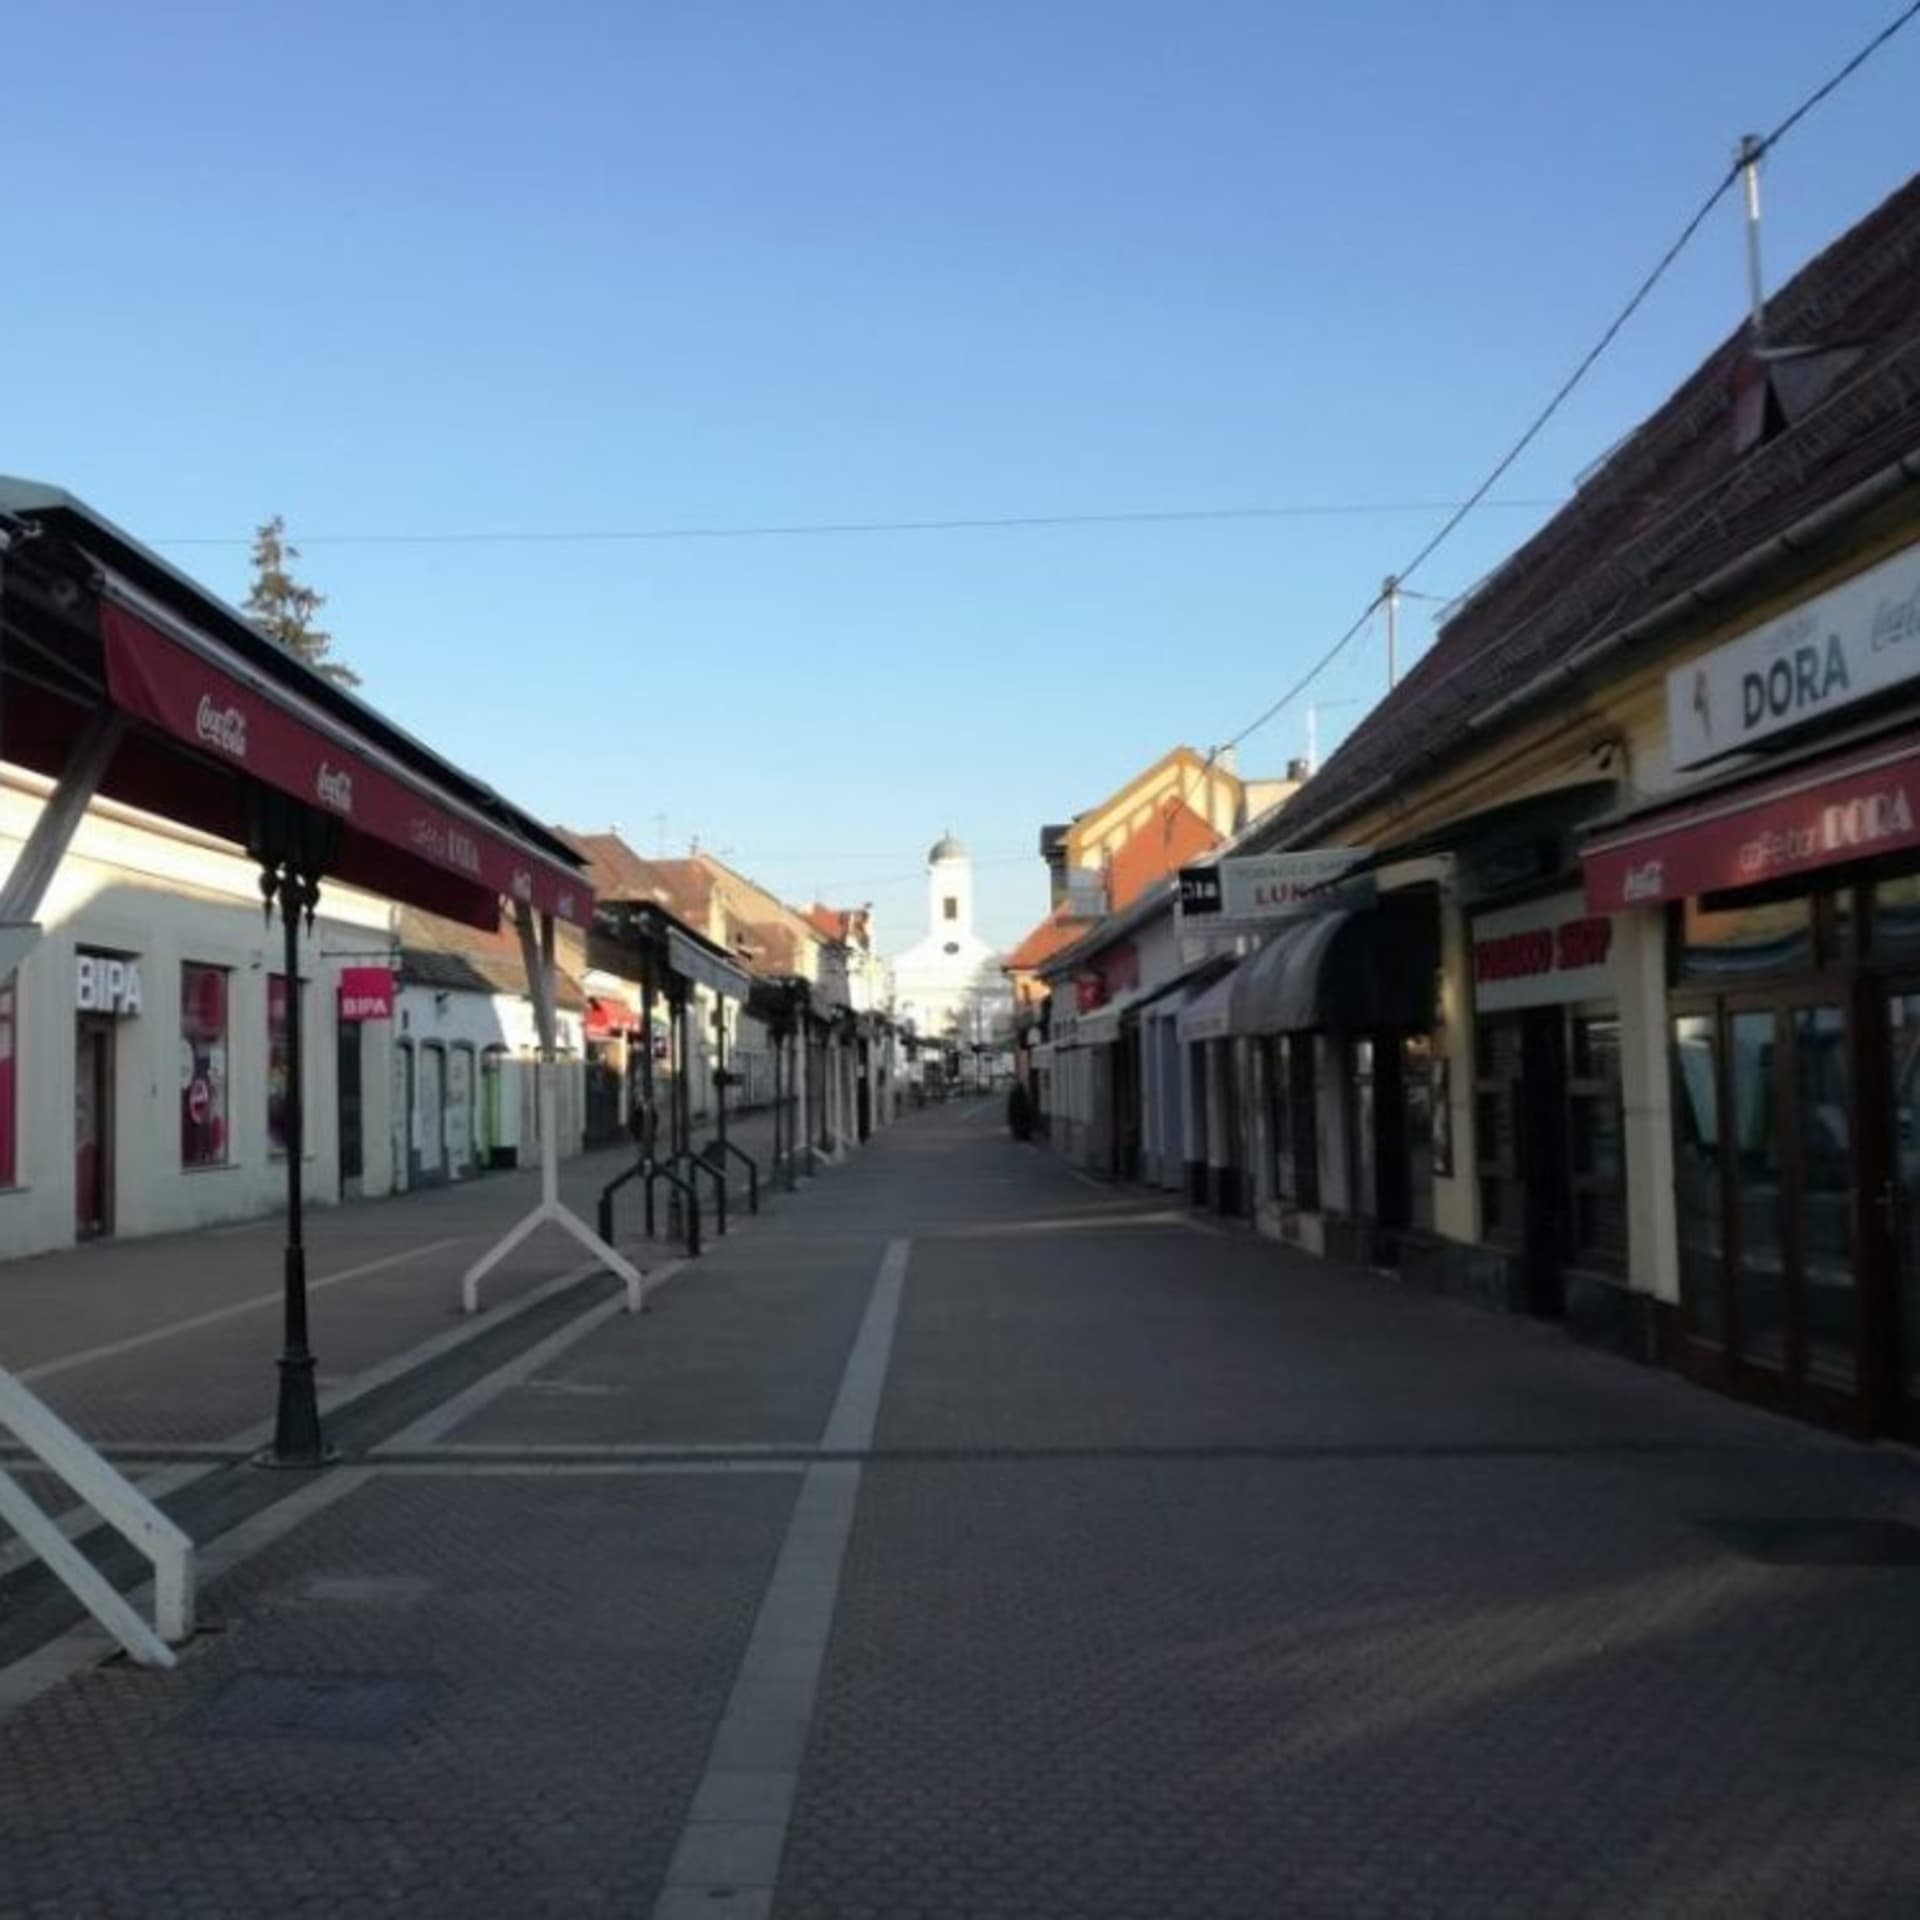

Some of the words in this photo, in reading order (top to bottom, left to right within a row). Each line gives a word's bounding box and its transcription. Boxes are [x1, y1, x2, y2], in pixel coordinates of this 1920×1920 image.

[1743, 633, 1849, 730] DORA
[1822, 785, 1914, 850] DORA
[75, 956, 142, 1016] BIPA
[342, 998, 388, 1016] BIPA
